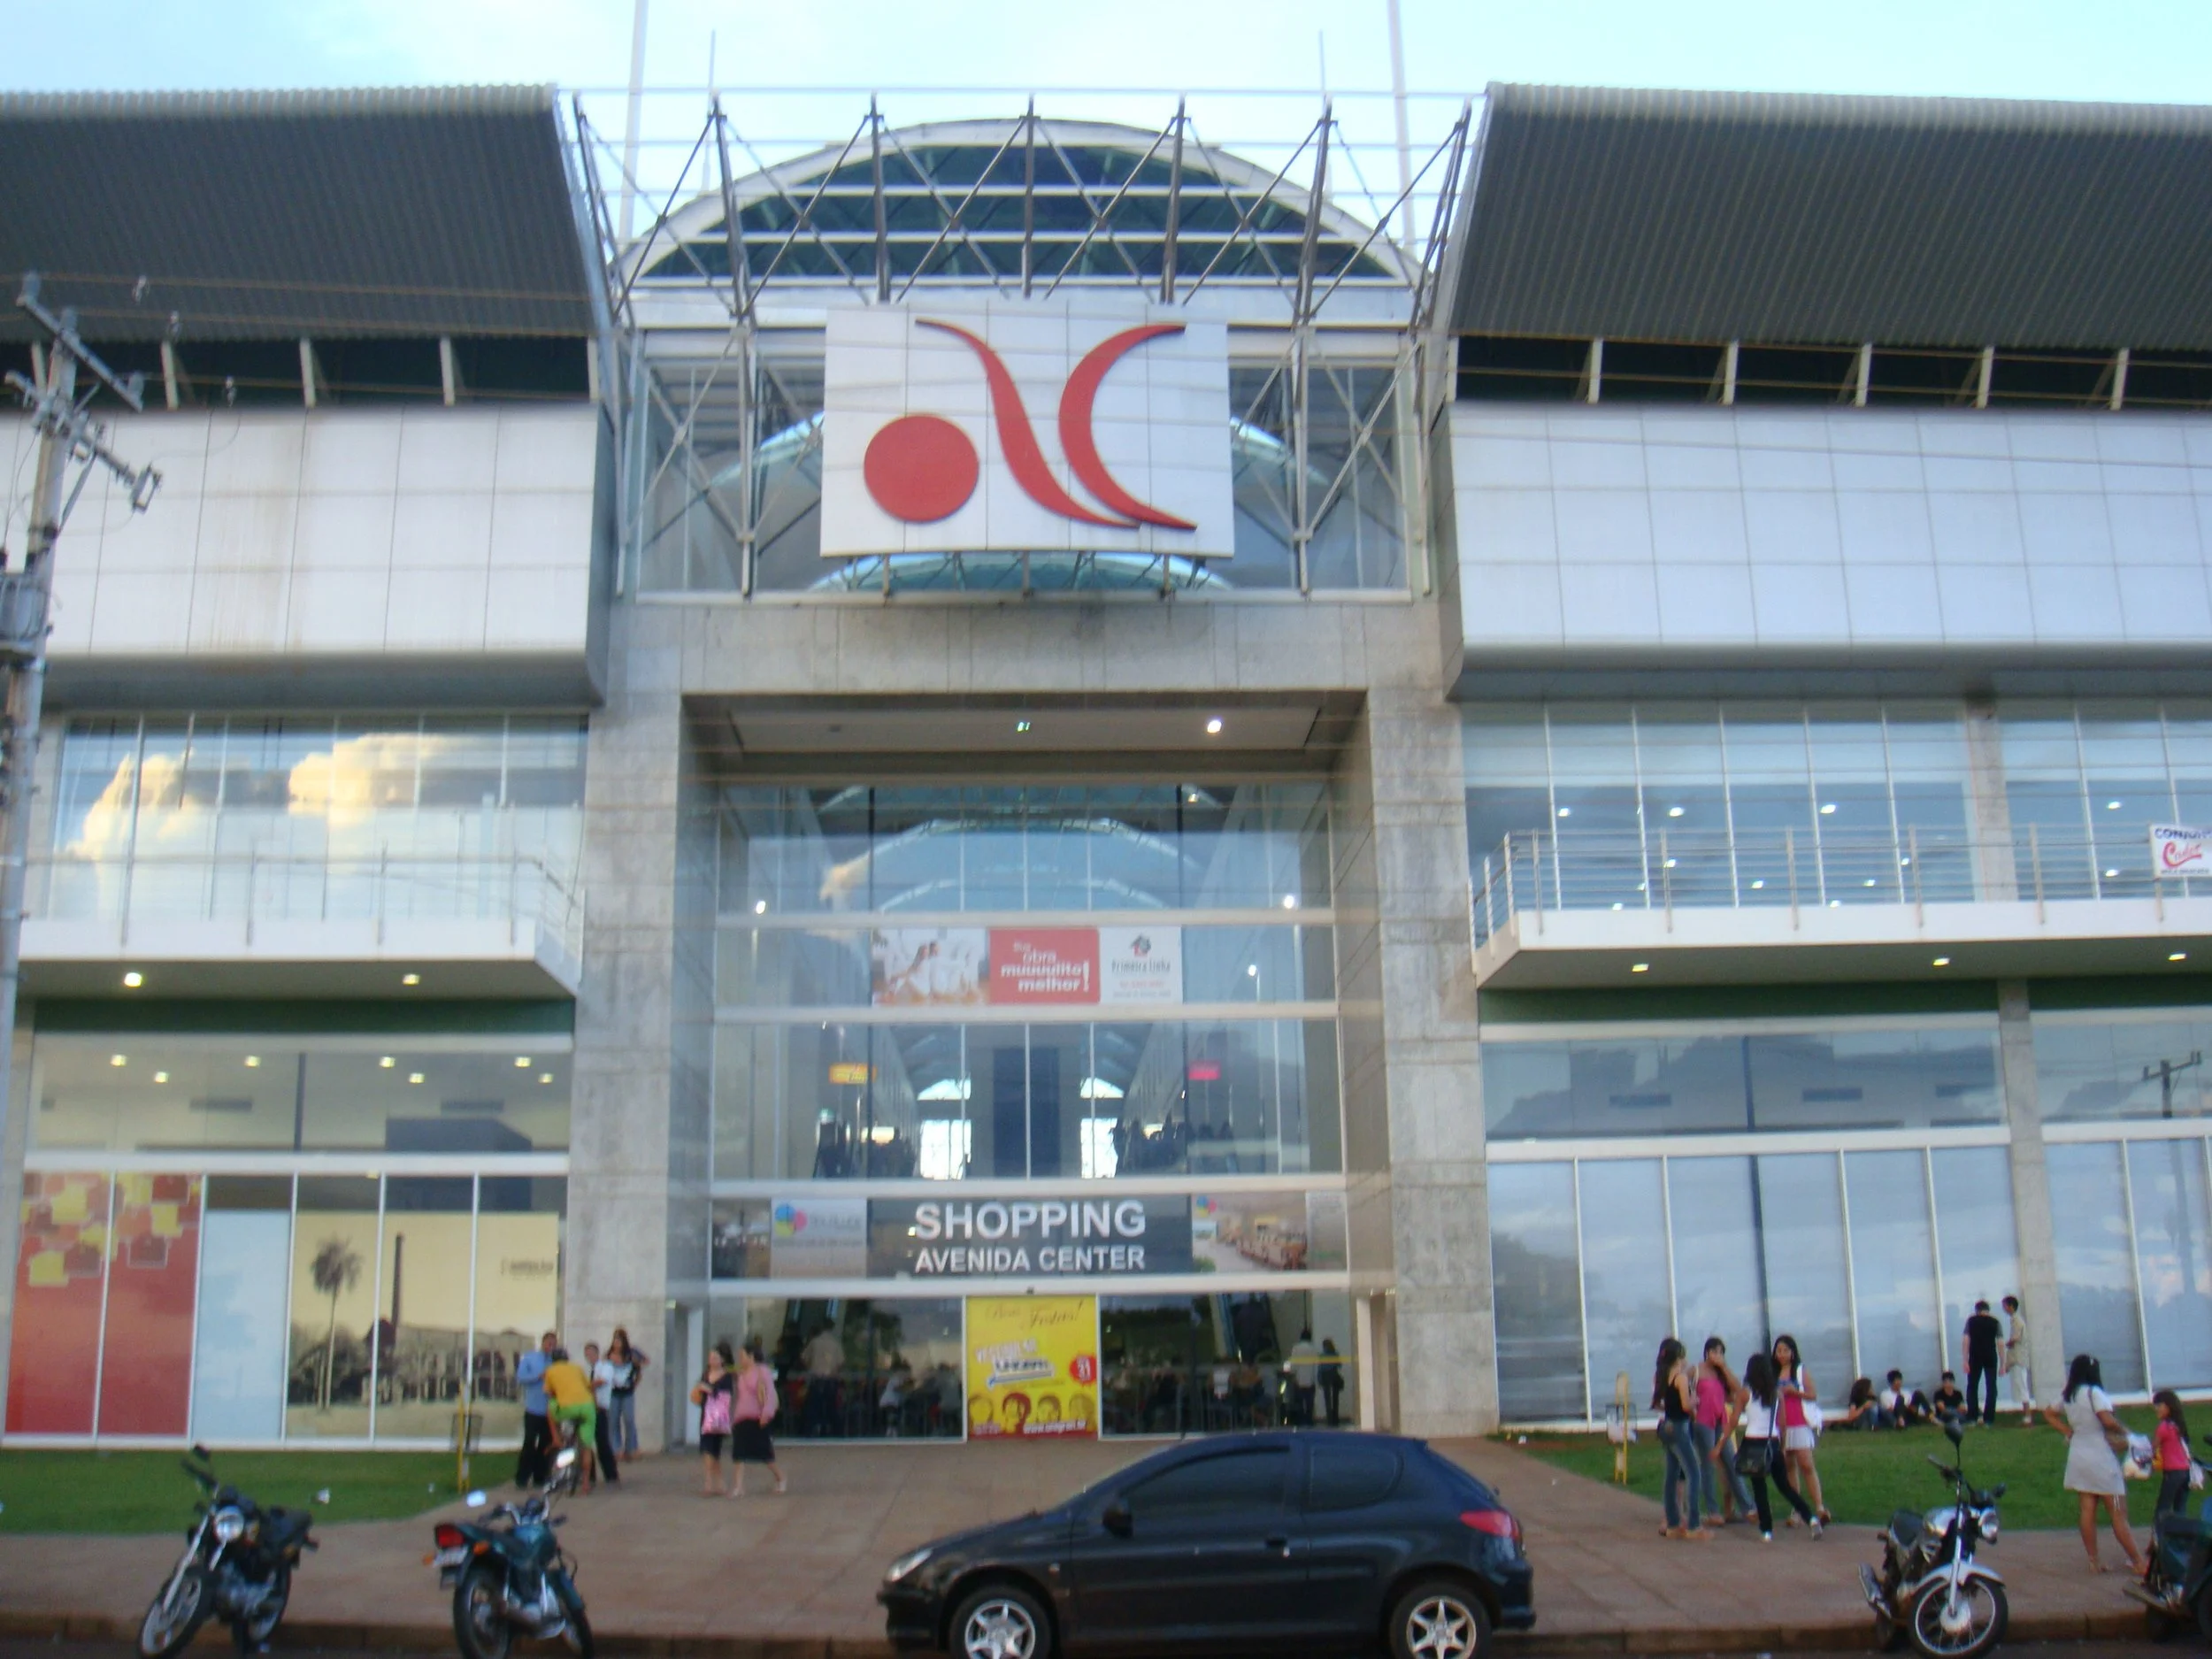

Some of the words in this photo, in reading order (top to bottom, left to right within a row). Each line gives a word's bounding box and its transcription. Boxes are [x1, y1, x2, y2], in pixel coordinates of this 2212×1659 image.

[1022, 948, 1056, 963] obra
[915, 1199, 1146, 1240] SHOPPING
[915, 1247, 1031, 1273] AVENIDA
[1039, 1245, 1145, 1271] CENTER
